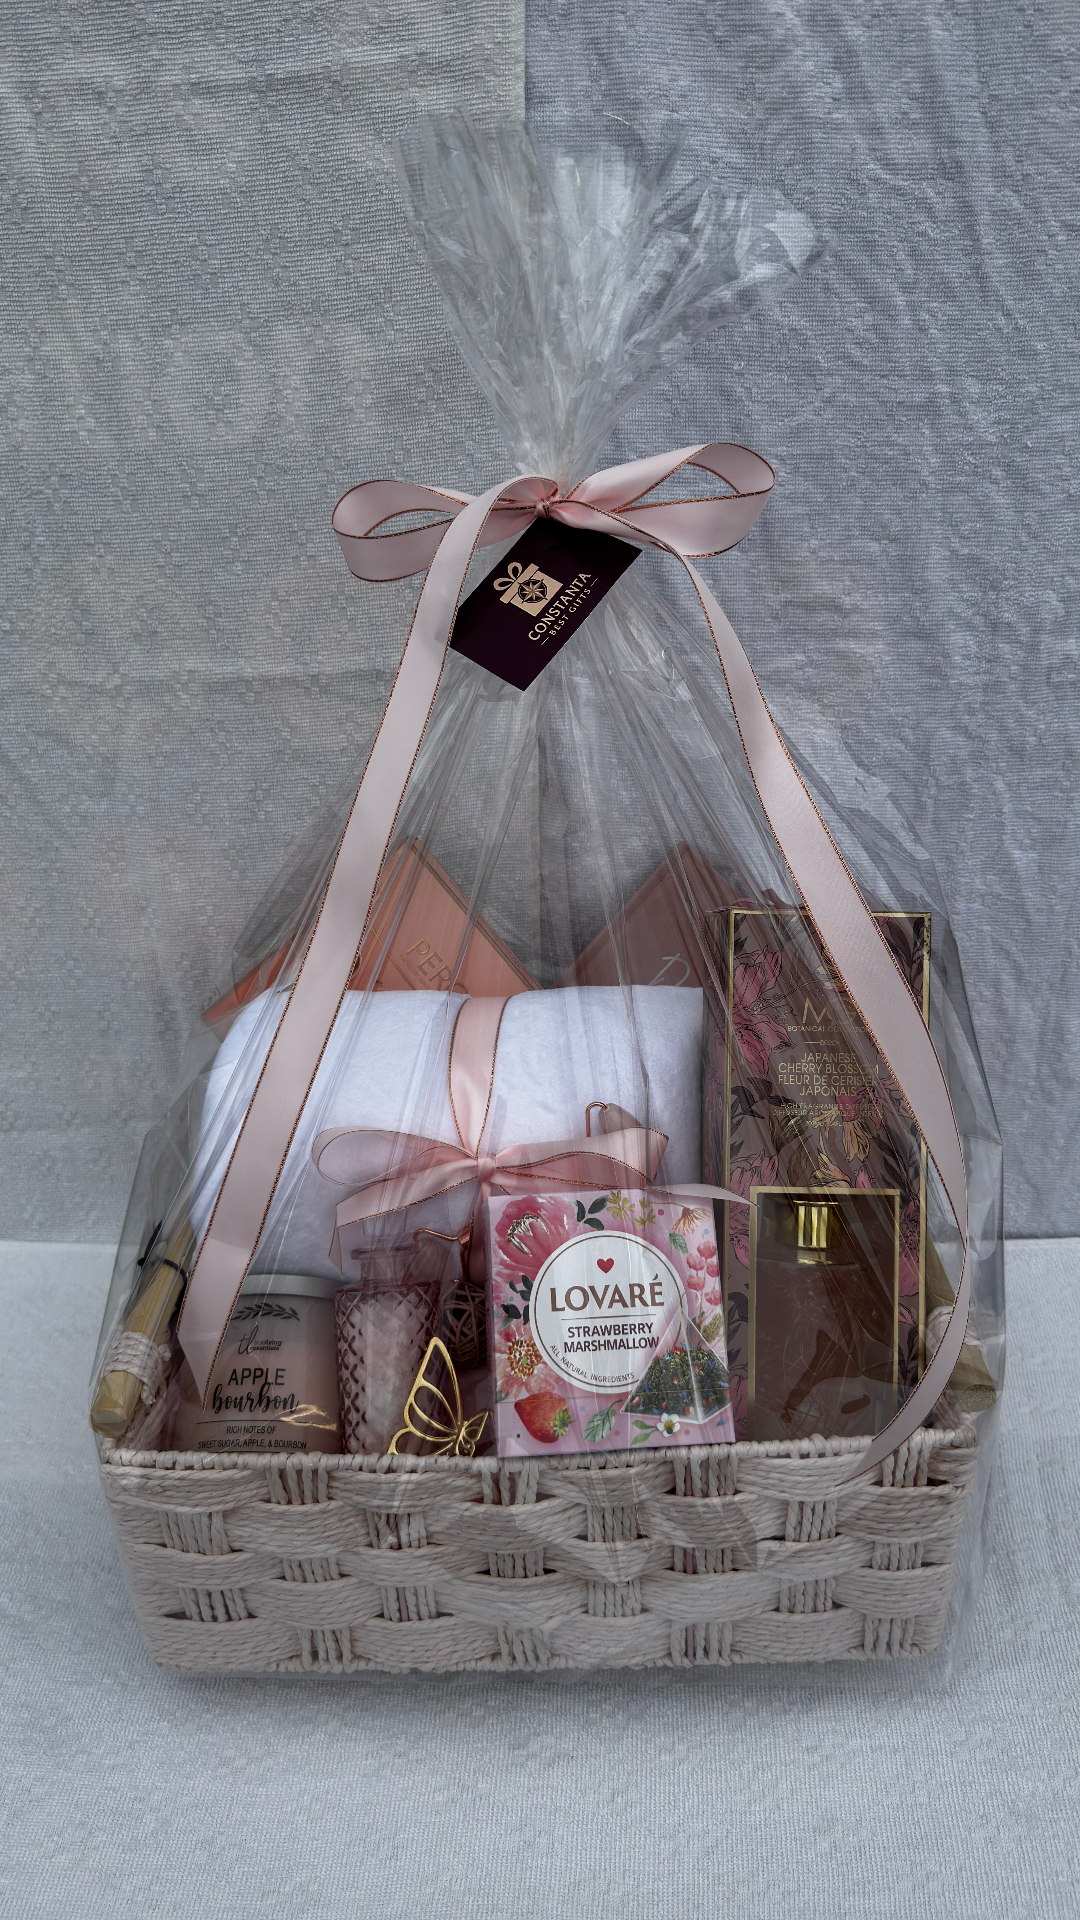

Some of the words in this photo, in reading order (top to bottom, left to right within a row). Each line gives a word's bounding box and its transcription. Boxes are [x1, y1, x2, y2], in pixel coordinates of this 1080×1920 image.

[528, 572, 592, 641] CONSTANTA
[549, 614, 569, 636] BEST
[569, 588, 591, 613] GIFTS
[800, 1052, 857, 1063] JAPANESE
[778, 1063, 822, 1073] CHERRY
[825, 1063, 879, 1075] BLOSSOM
[778, 1074, 810, 1085] FLEUR
[813, 1075, 828, 1085] DE
[799, 1086, 857, 1097] JAPONAIS
[549, 1273, 665, 1312] LOVARÉ
[567, 1322, 654, 1339] STRAWBERRY
[563, 1336, 660, 1354] MARSHMALLOW
[549, 1344, 560, 1358] ALL
[560, 1356, 588, 1379] NATURAL
[590, 1372, 635, 1383] INGREDIENTS
[228, 1367, 287, 1386] APPLE
[212, 1383, 300, 1415] bourbon
[226, 1425, 242, 1434] RICH
[243, 1425, 266, 1434] NOTES
[266, 1425, 277, 1434] OF
[197, 1440, 218, 1449] SWEET
[217, 1439, 242, 1448] SUGAR,
[242, 1438, 267, 1449] APPLE,
[267, 1439, 273, 1448] &
[274, 1439, 307, 1450] BOURBON
